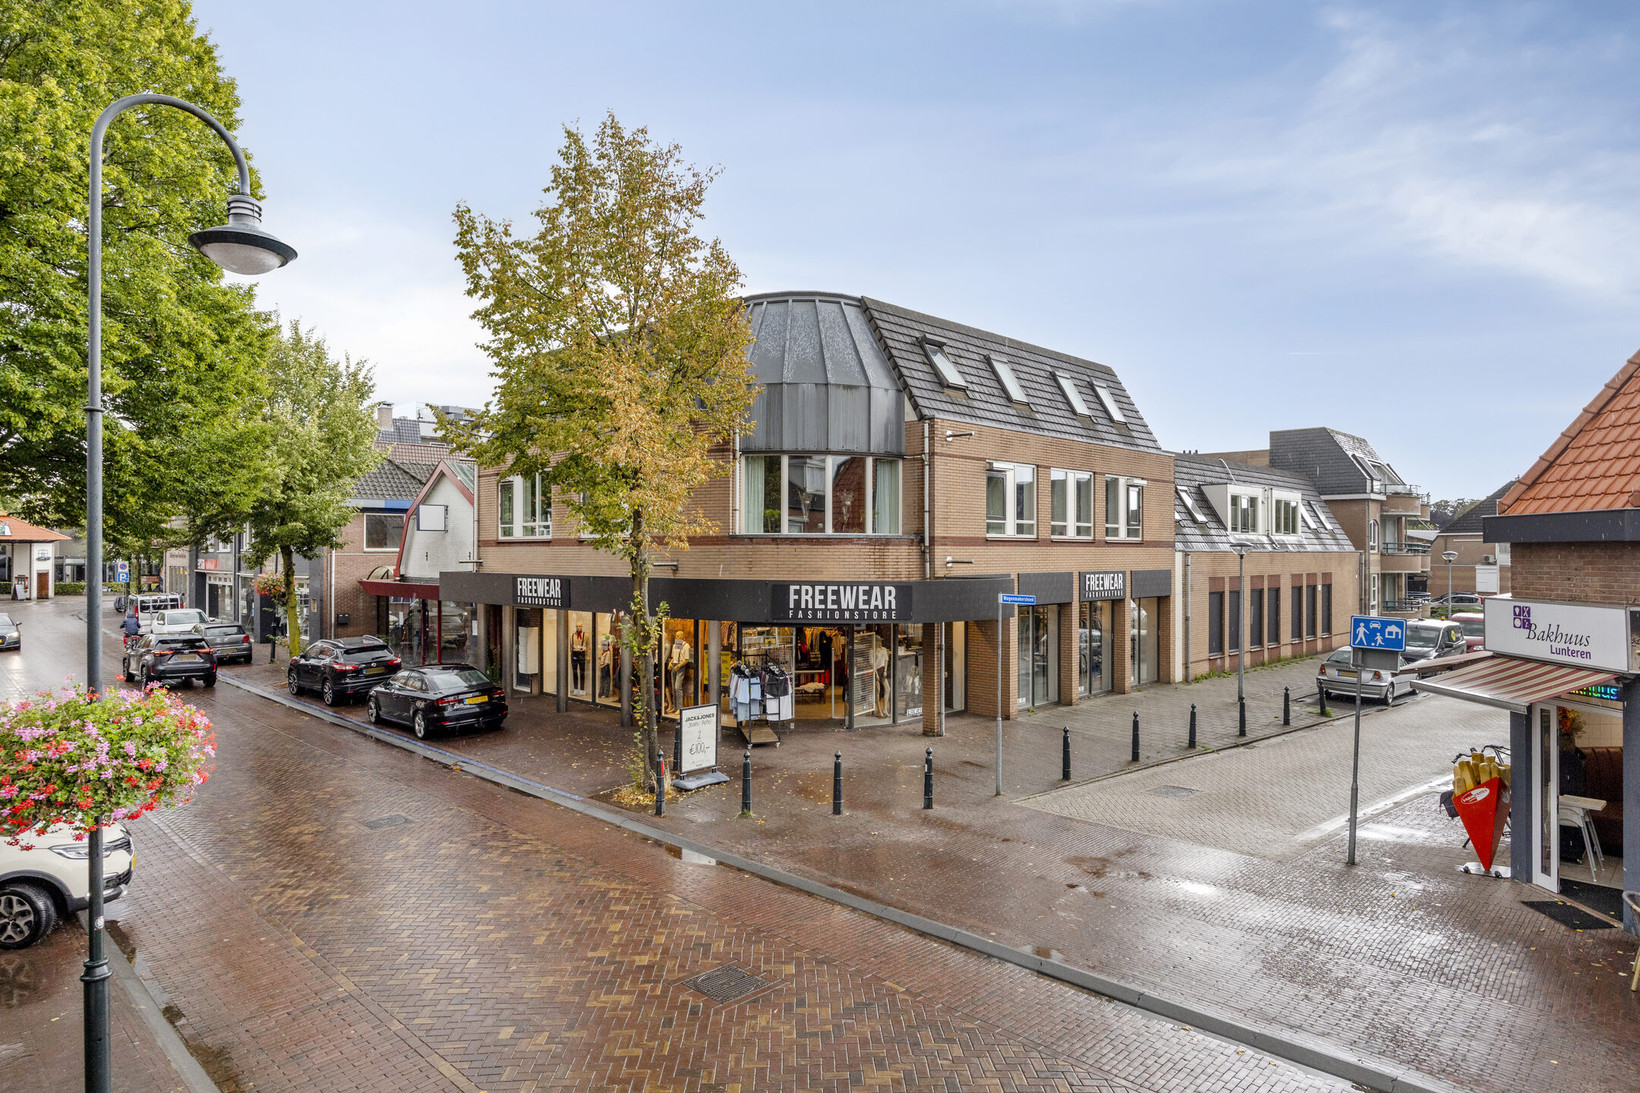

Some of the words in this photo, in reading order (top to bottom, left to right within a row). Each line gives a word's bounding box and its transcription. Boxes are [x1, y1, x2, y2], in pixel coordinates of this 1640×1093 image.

[517, 577, 561, 598] FREEWEAR
[1085, 573, 1123, 590] FREEWEAR
[517, 596, 562, 606] FASHIONSTORE
[789, 585, 896, 609] FREEWEAR
[1085, 590, 1123, 598] FASHIONSTORE
[788, 609, 896, 619] FASHIONSTORE
[1526, 623, 1590, 647] Bakhuus
[1550, 644, 1591, 660] Lunteren
[685, 713, 715, 722] JACK&JONES
